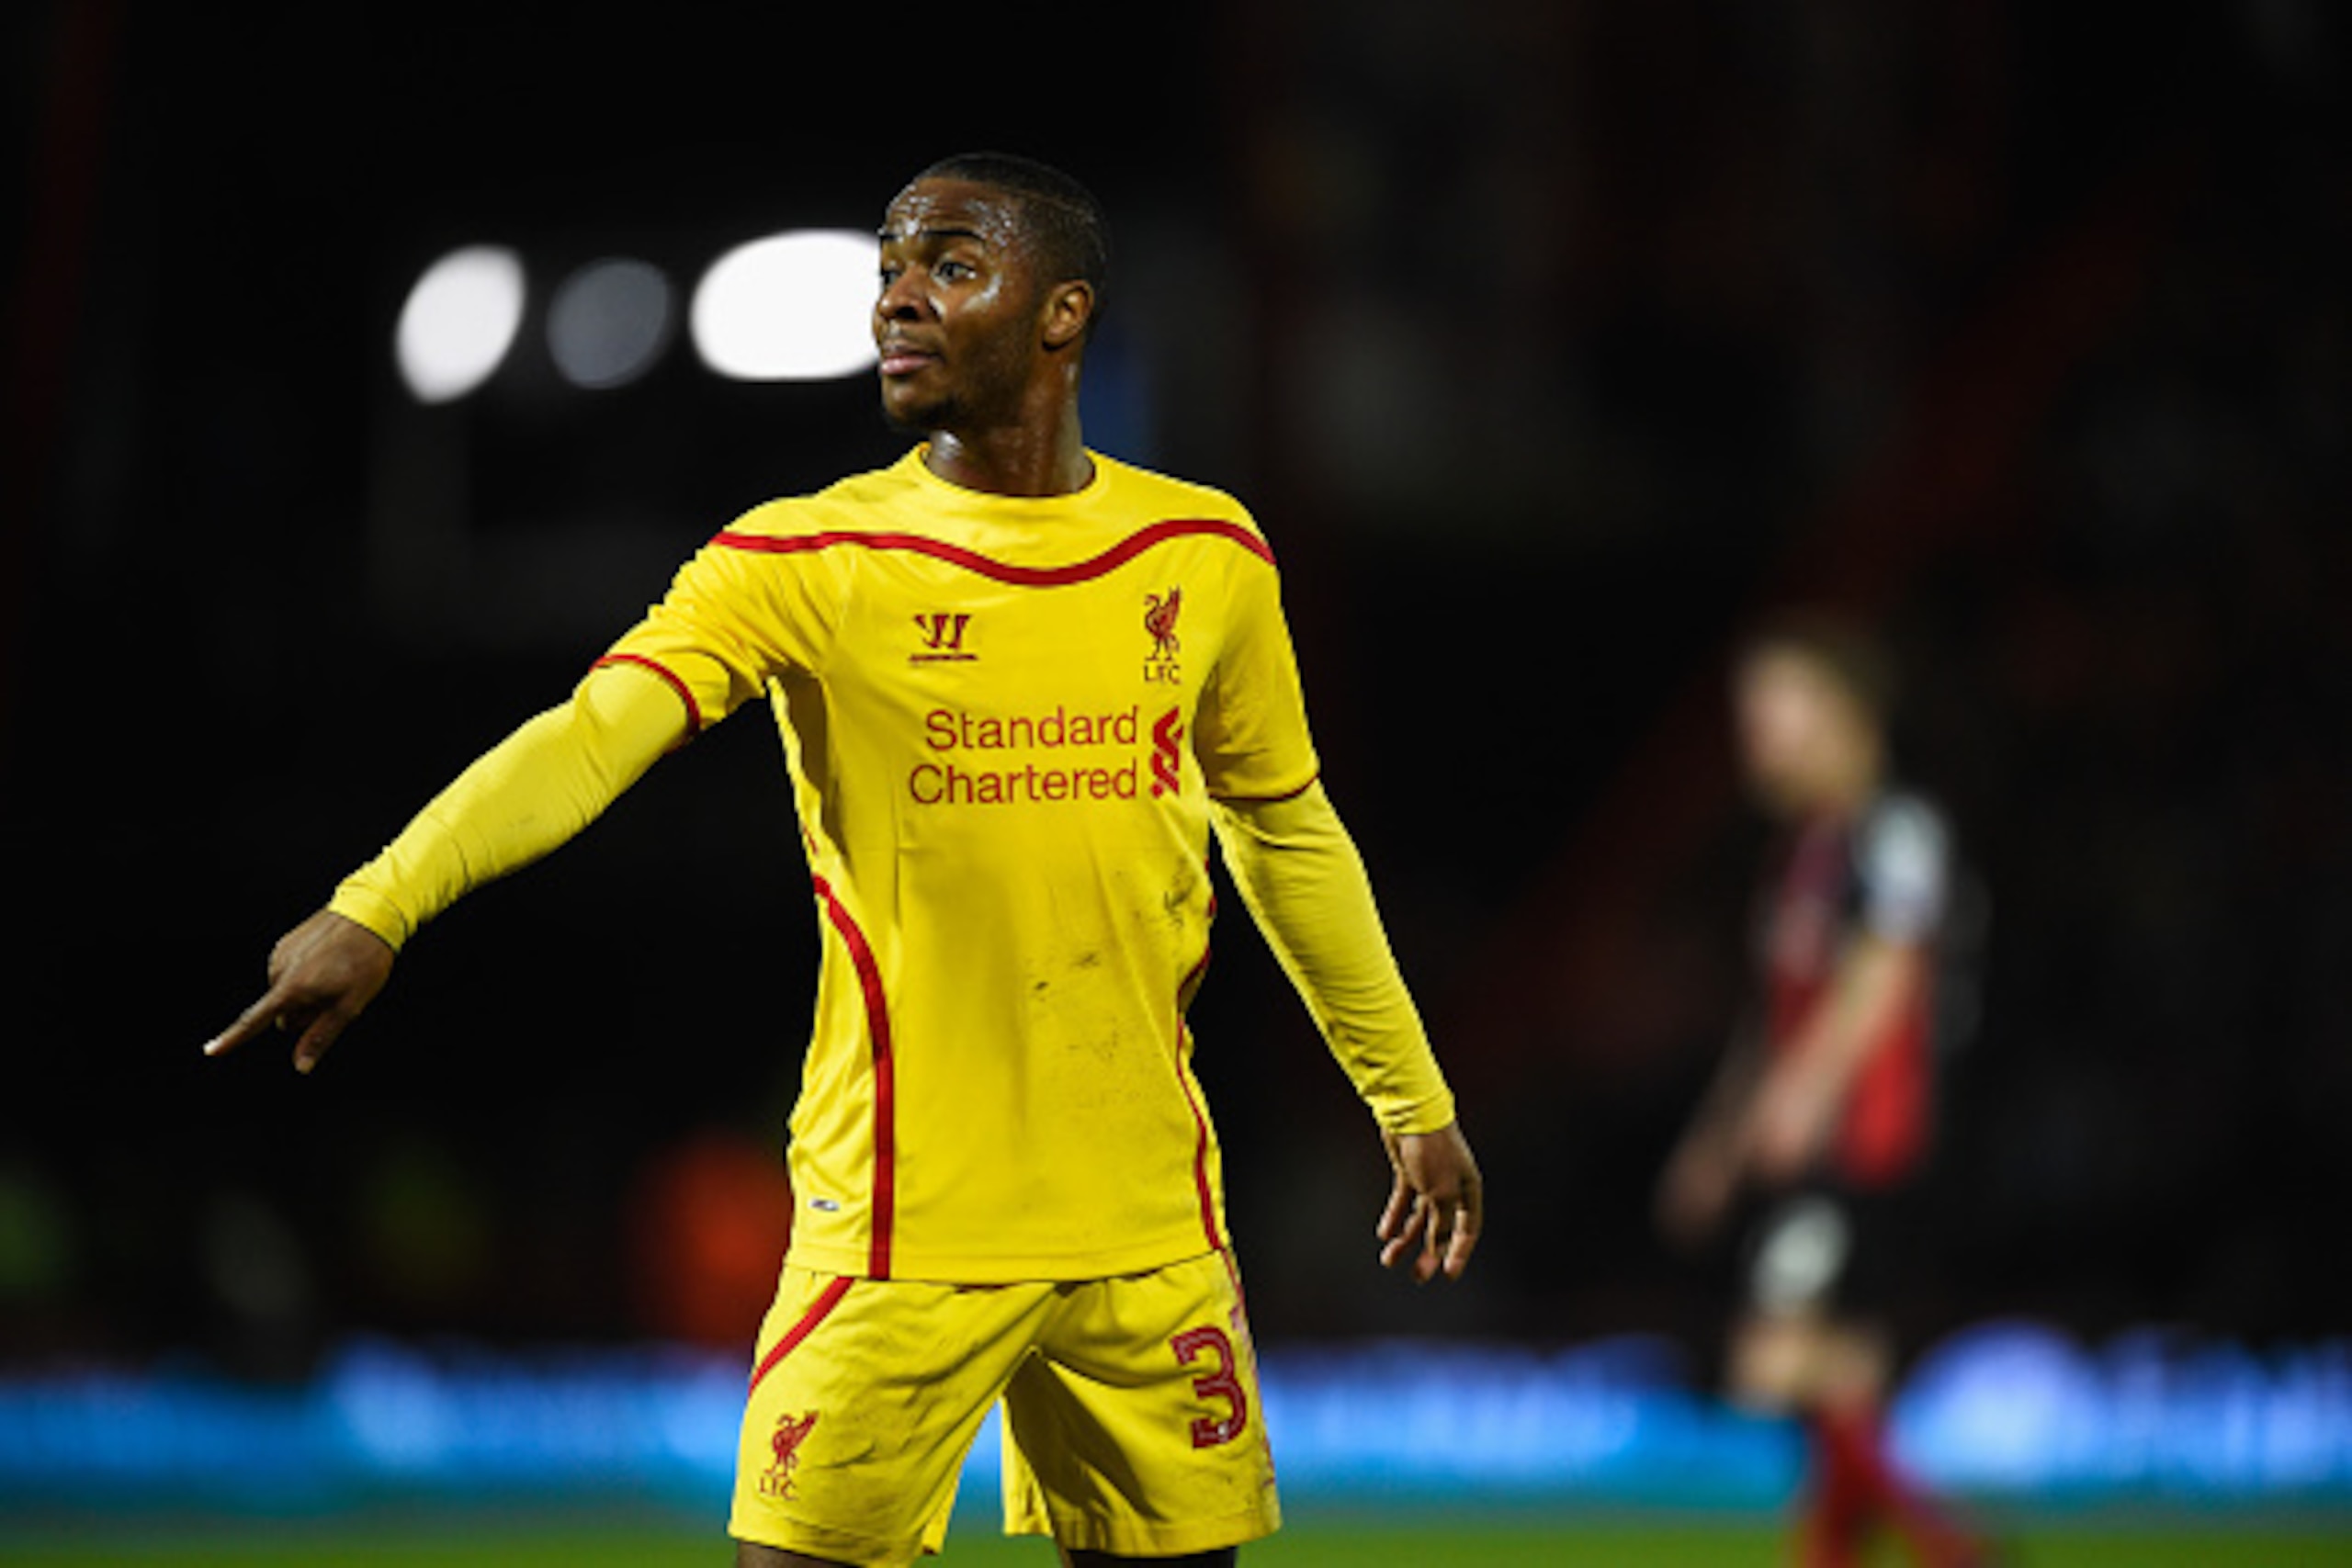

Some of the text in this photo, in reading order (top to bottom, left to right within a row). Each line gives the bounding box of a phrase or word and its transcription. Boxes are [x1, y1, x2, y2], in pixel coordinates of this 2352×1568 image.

[1144, 664, 1182, 685] LFC
[925, 705, 1137, 751] Standard
[909, 757, 1137, 805] Chartered
